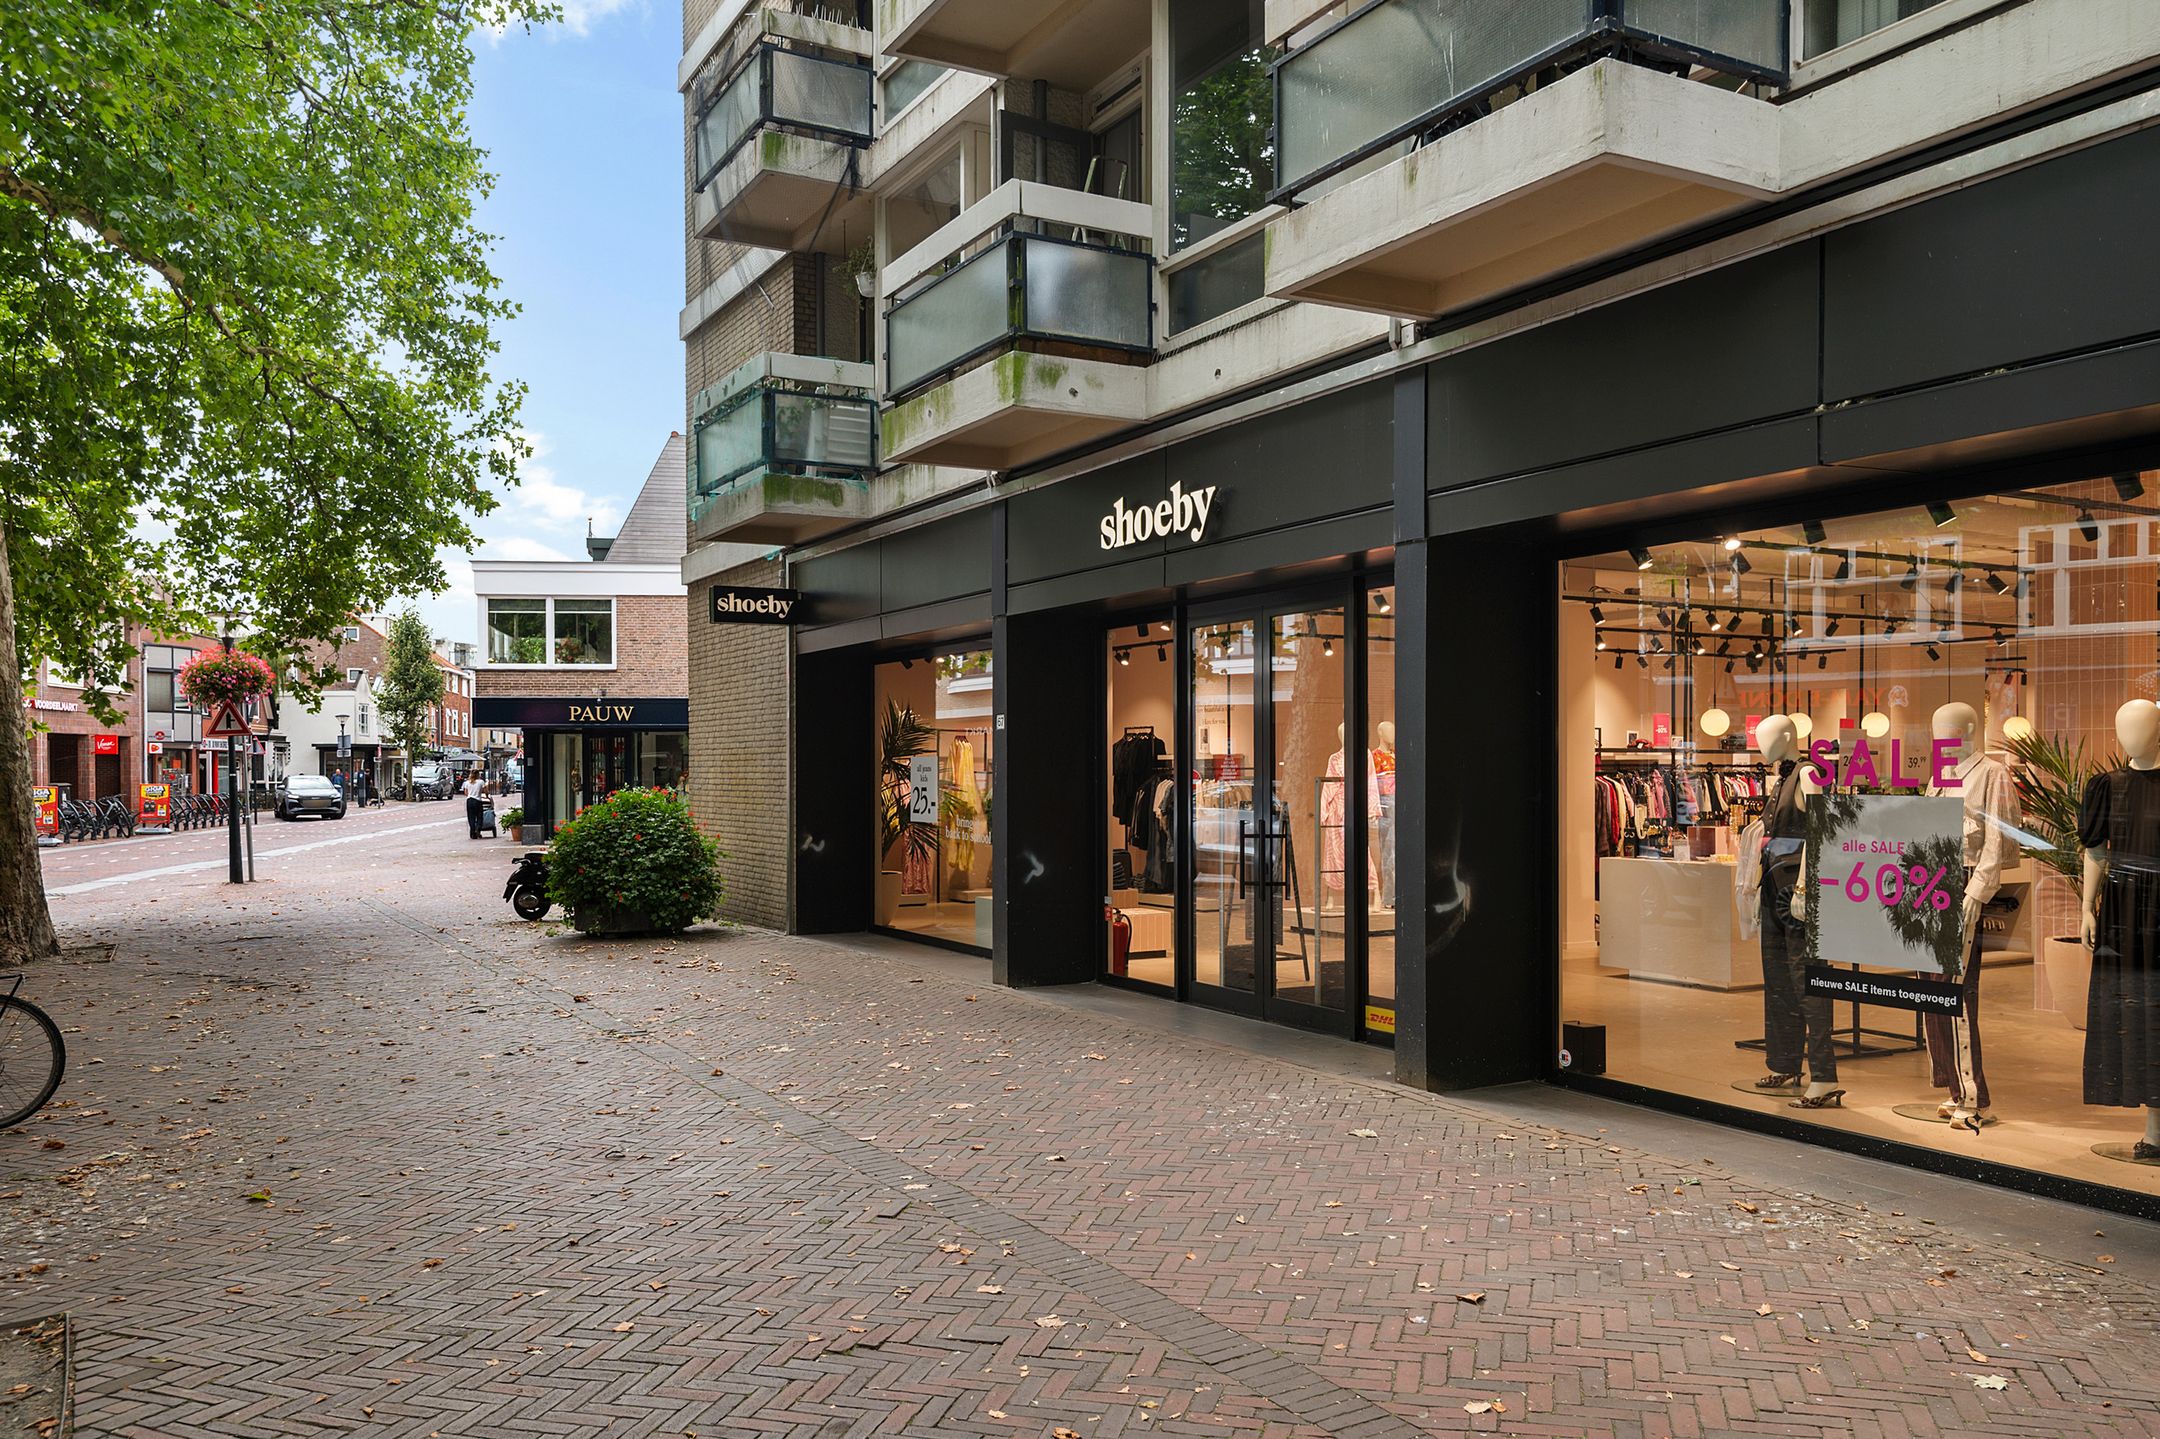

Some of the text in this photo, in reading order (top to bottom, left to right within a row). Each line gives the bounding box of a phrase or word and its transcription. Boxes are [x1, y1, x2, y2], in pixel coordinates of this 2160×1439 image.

[1100, 480, 1216, 550] shoeby
[717, 592, 794, 619] shoeby
[568, 705, 635, 721] PAUW
[1808, 738, 1963, 787] SALE
[1842, 840, 1905, 855] alle SALE
[1819, 861, 1951, 911] -60%
[1810, 977, 1957, 1007] nieuwe SALE items toegevoegd
[1369, 1013, 1395, 1026] DHL
